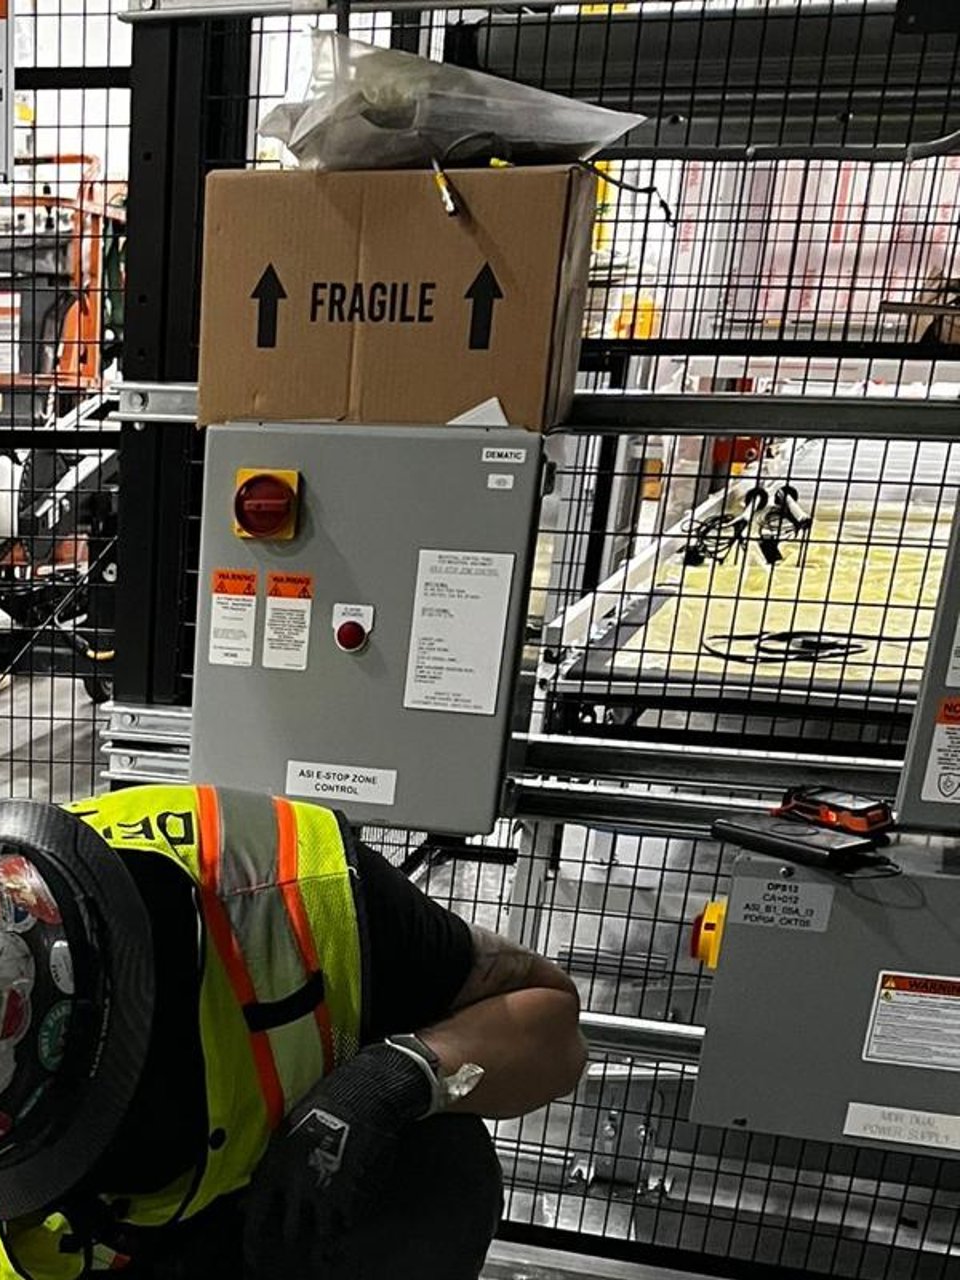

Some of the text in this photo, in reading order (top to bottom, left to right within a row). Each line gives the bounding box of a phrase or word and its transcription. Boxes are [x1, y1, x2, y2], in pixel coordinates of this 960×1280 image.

[310, 282, 436, 323] FRAGILE
[485, 451, 524, 461] DEMATIC
[298, 769, 377, 785] ASI E-STOP ZONE
[314, 783, 359, 795] CONTROL
